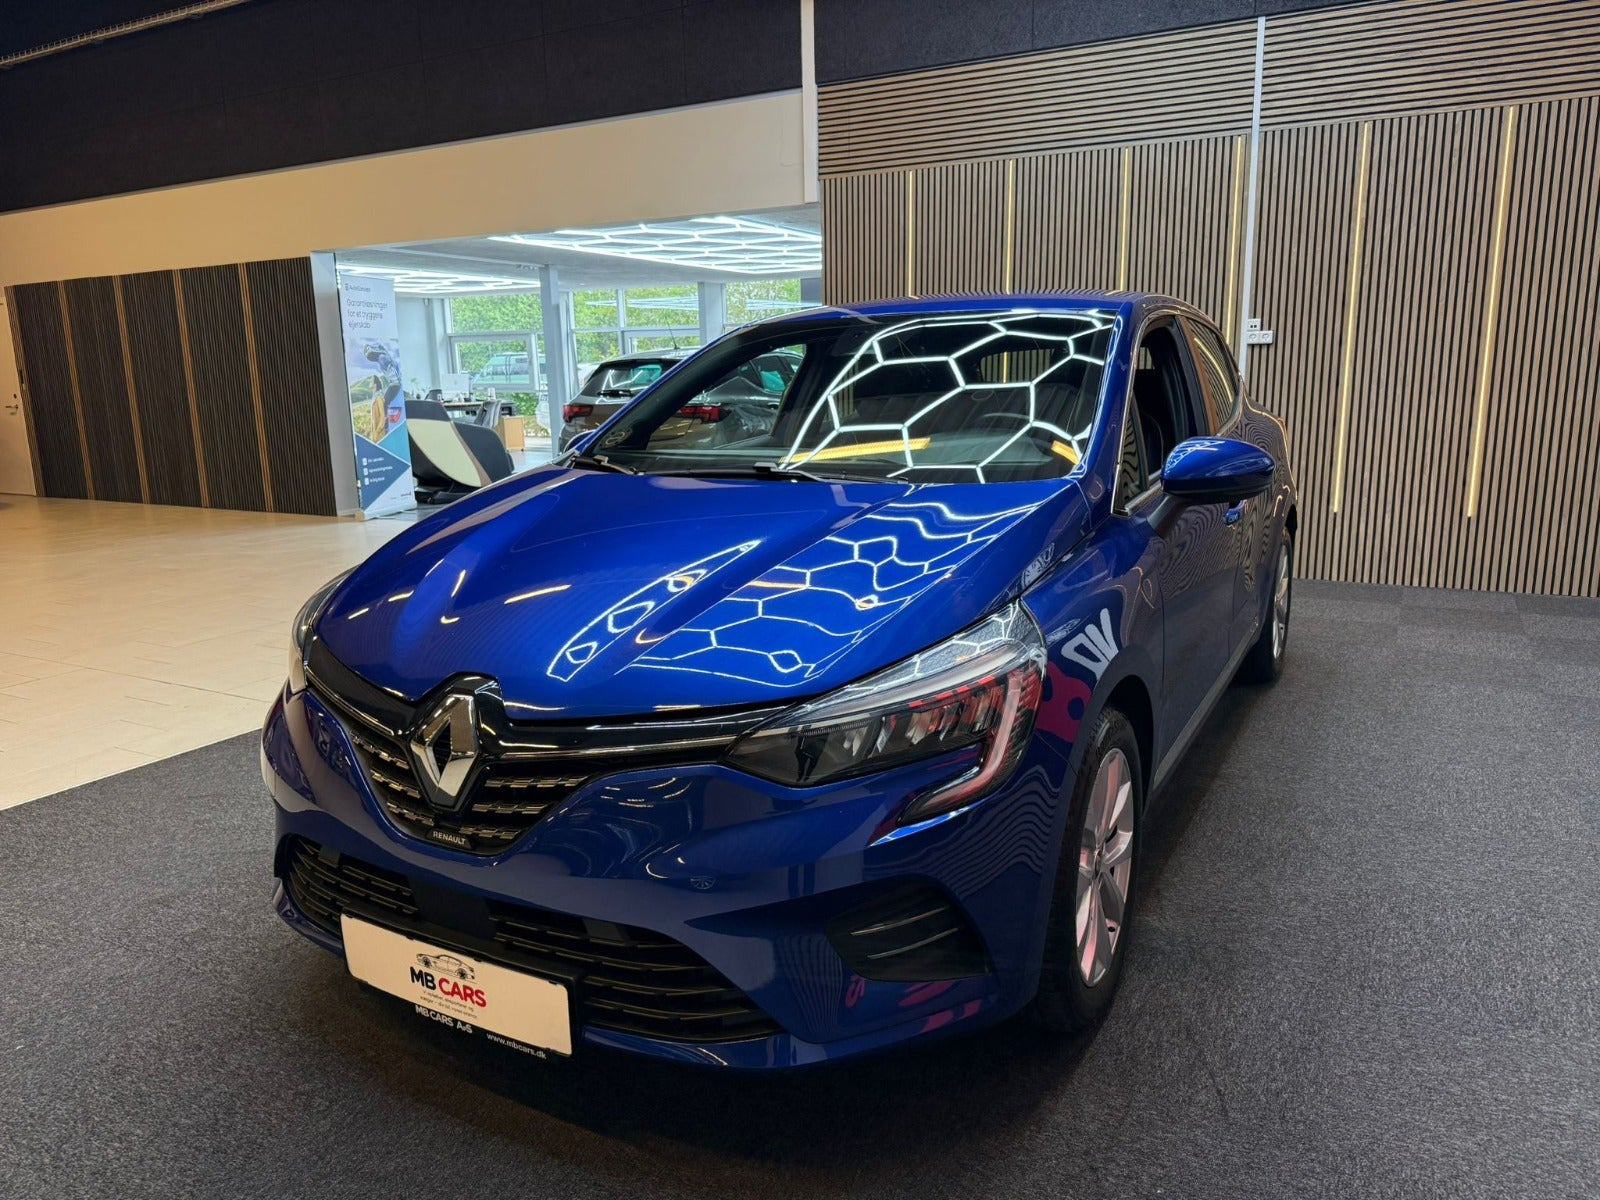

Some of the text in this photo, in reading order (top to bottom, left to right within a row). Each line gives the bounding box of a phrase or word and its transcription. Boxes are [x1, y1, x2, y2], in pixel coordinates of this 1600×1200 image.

[432, 830, 467, 845] RENAULT
[409, 966, 437, 991] MB
[438, 977, 487, 1008] CARS
[415, 1004, 430, 1018] MB
[429, 1010, 454, 1027] CARS
[486, 1033, 547, 1060] www.mbcars.dk
